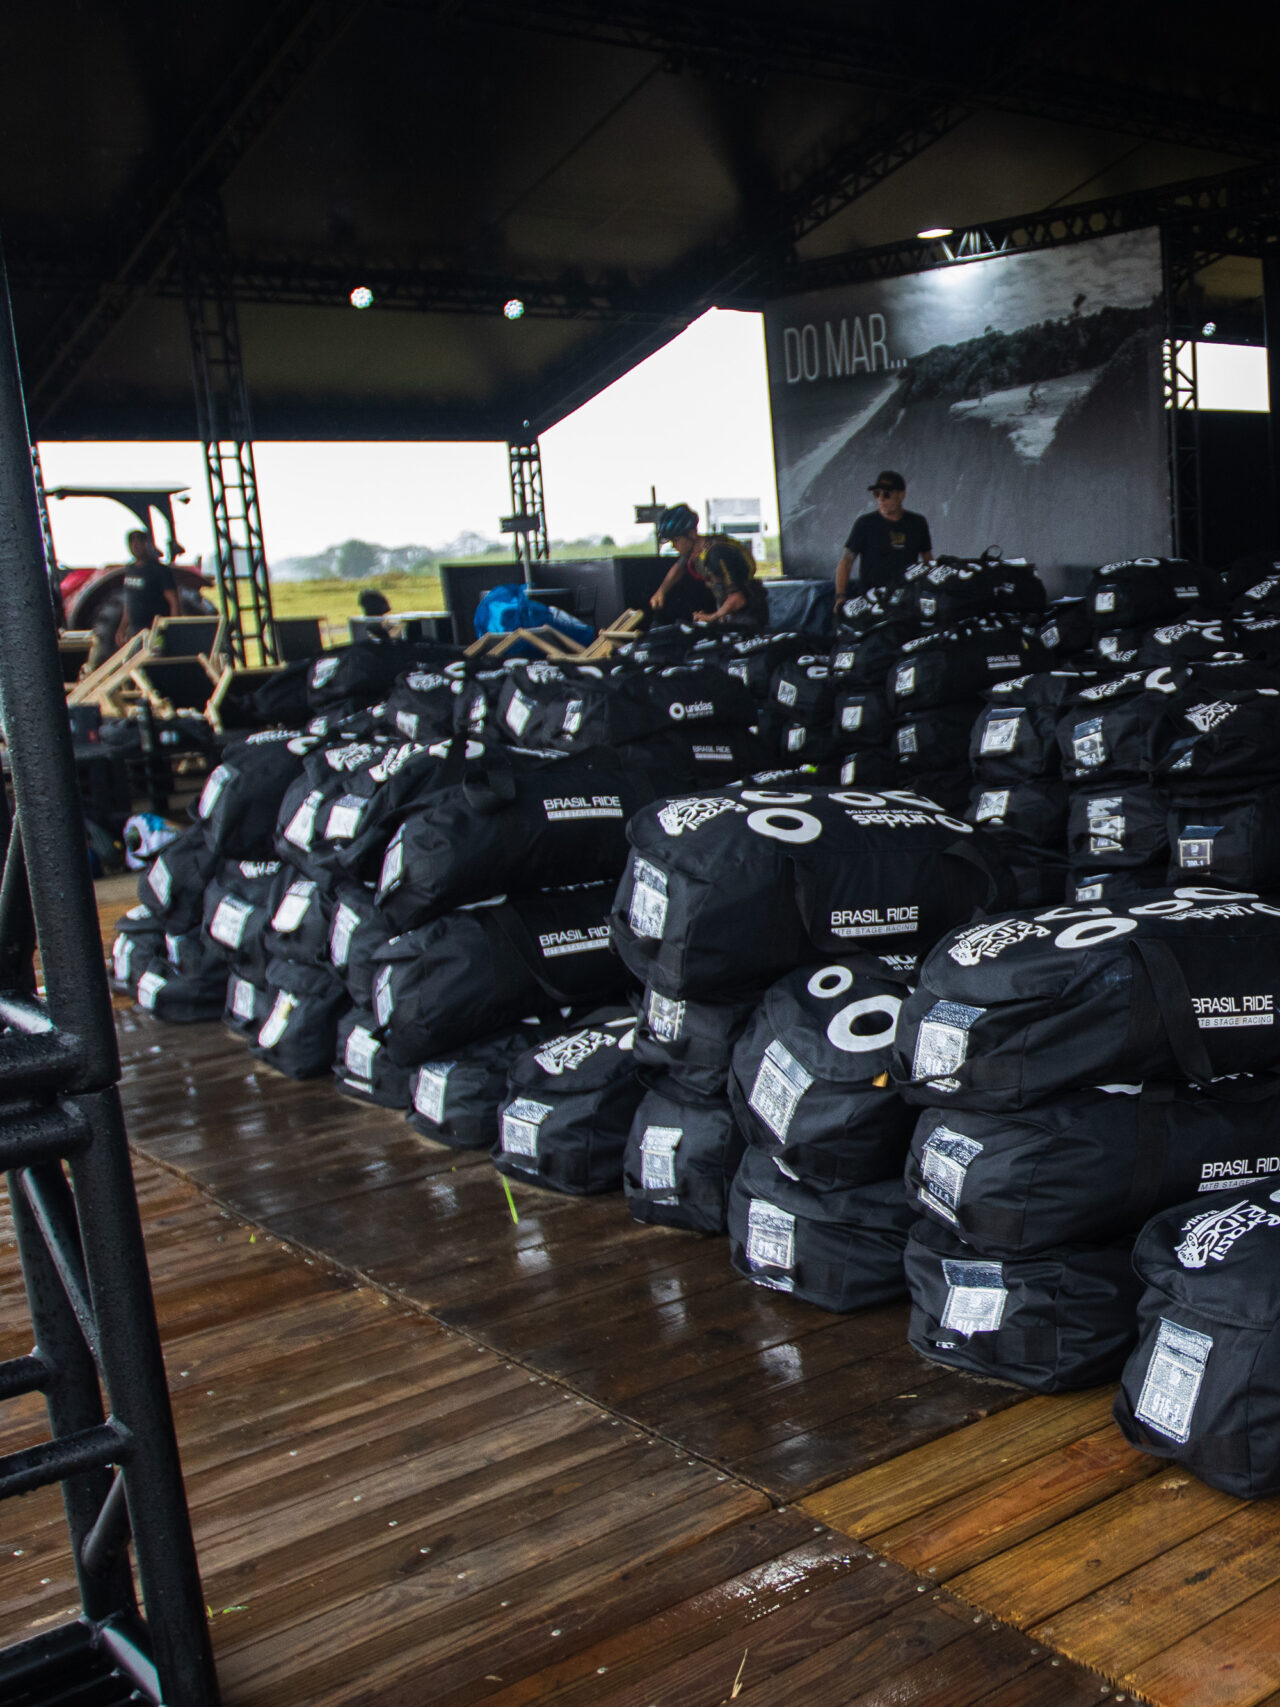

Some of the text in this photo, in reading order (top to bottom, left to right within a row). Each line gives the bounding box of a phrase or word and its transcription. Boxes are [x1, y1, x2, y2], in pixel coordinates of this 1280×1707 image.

[784, 313, 908, 384] DO MAR...
[685, 702, 712, 713] unidas
[543, 796, 621, 811] BRASIL RIDE
[852, 813, 936, 828] unidas
[831, 906, 919, 925] BRASIL RIDE
[539, 925, 611, 947] BRASIL RID
[855, 925, 882, 935] STAGE
[885, 922, 917, 932] RACING
[1243, 995, 1274, 1010] RIDE
[1214, 1016, 1240, 1026] STAGE
[1242, 1014, 1272, 1025] RACING
[1201, 1159, 1253, 1179] BRASIL
[1201, 1181, 1220, 1190] MTB
[1181, 1209, 1221, 1231] BAHIA
[1197, 1203, 1268, 1252] RIDE
